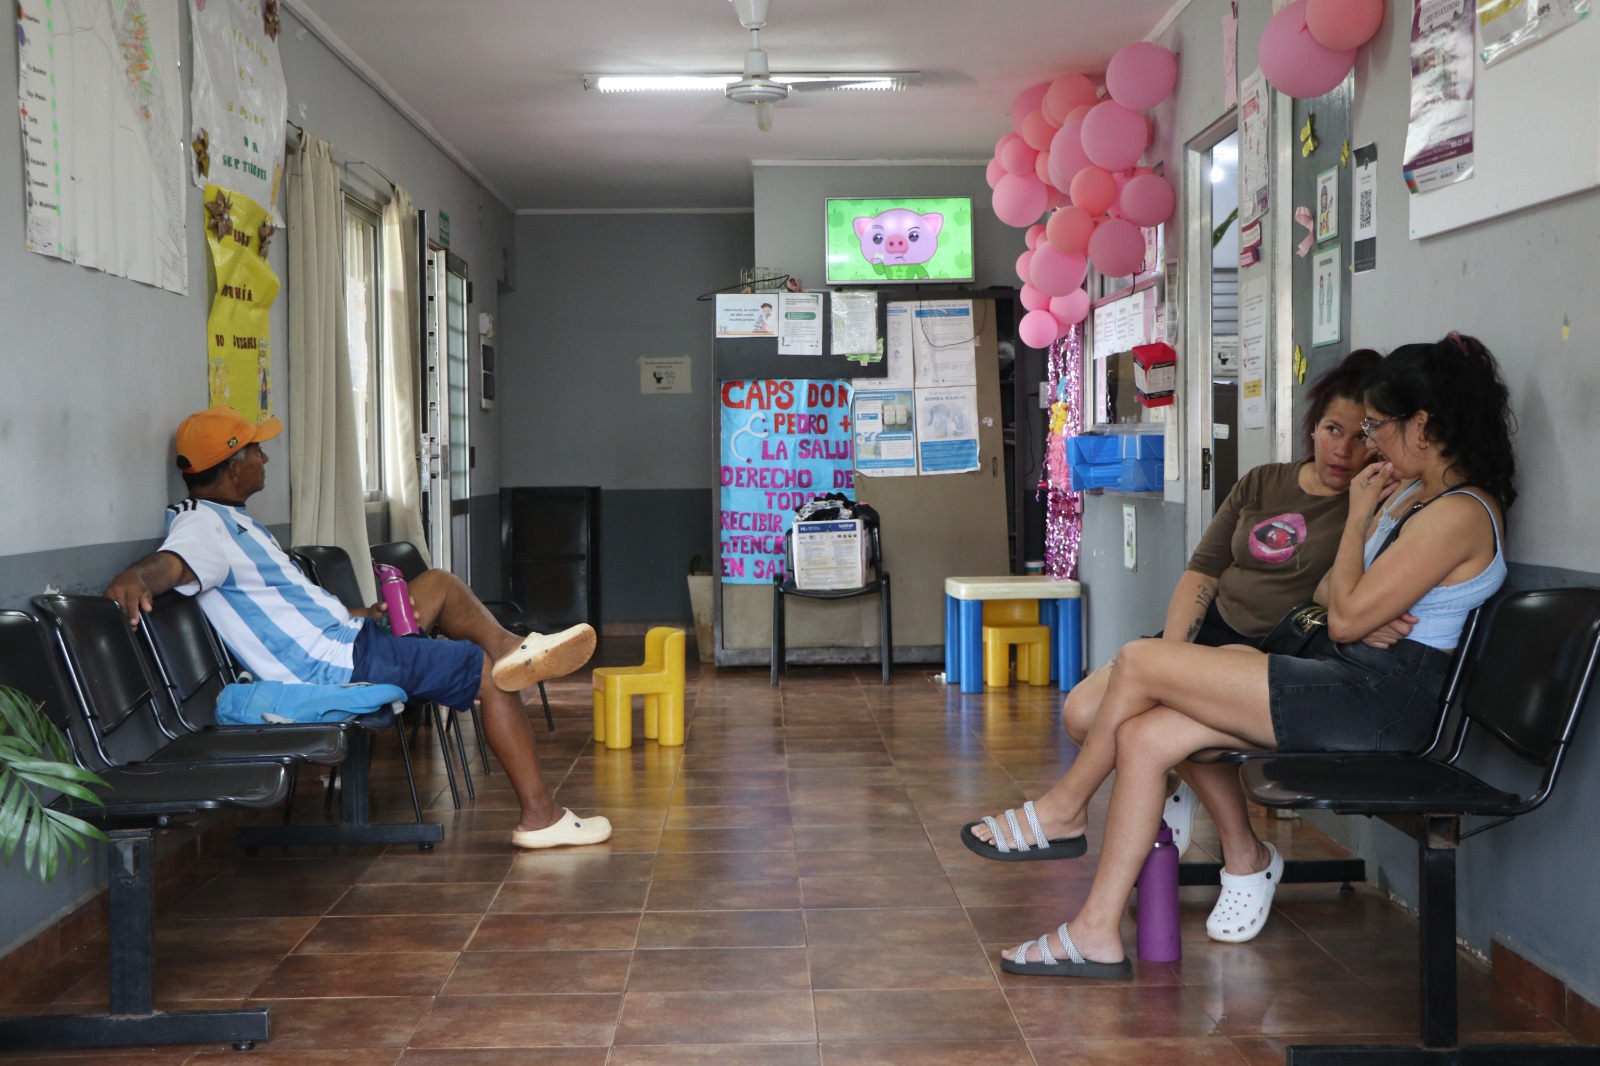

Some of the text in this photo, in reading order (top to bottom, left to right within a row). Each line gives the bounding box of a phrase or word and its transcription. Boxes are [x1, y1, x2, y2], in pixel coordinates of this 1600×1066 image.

[721, 380, 849, 410] CAPS DON
[773, 413, 829, 435] PEDRO
[762, 438, 854, 460] LA SALU
[721, 465, 855, 489] DERECHO DE
[721, 510, 783, 532] RECIBIR
[721, 557, 745, 577] EN
